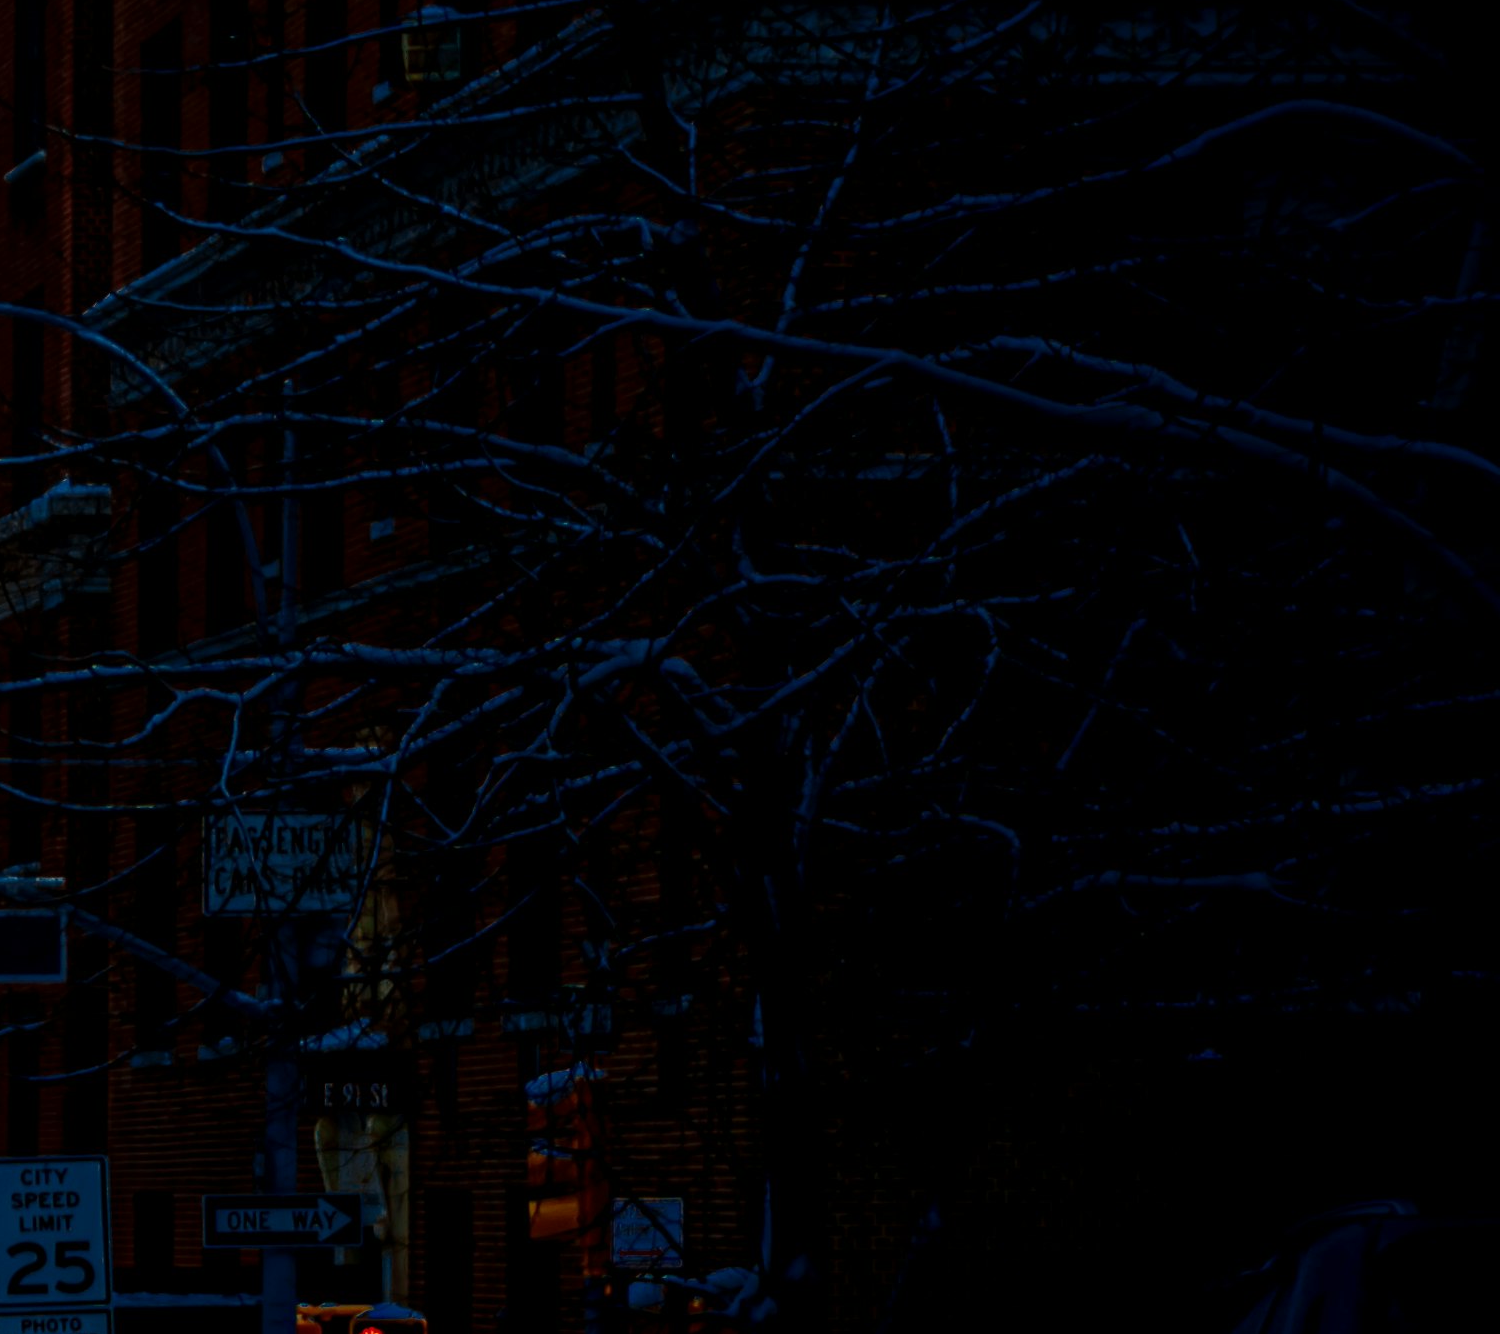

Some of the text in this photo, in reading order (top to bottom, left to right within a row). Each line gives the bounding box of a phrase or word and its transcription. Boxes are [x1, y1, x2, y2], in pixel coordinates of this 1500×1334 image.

[324, 1082, 334, 1107] E
[342, 1082, 362, 1108] 91
[20, 1168, 68, 1186] CITY
[11, 1191, 80, 1209] SPEED
[19, 1215, 74, 1233] LIMIT
[227, 1210, 337, 1230] ONE WAY
[7, 1241, 95, 1295] 25
[21, 1318, 81, 1333] PHOTO
